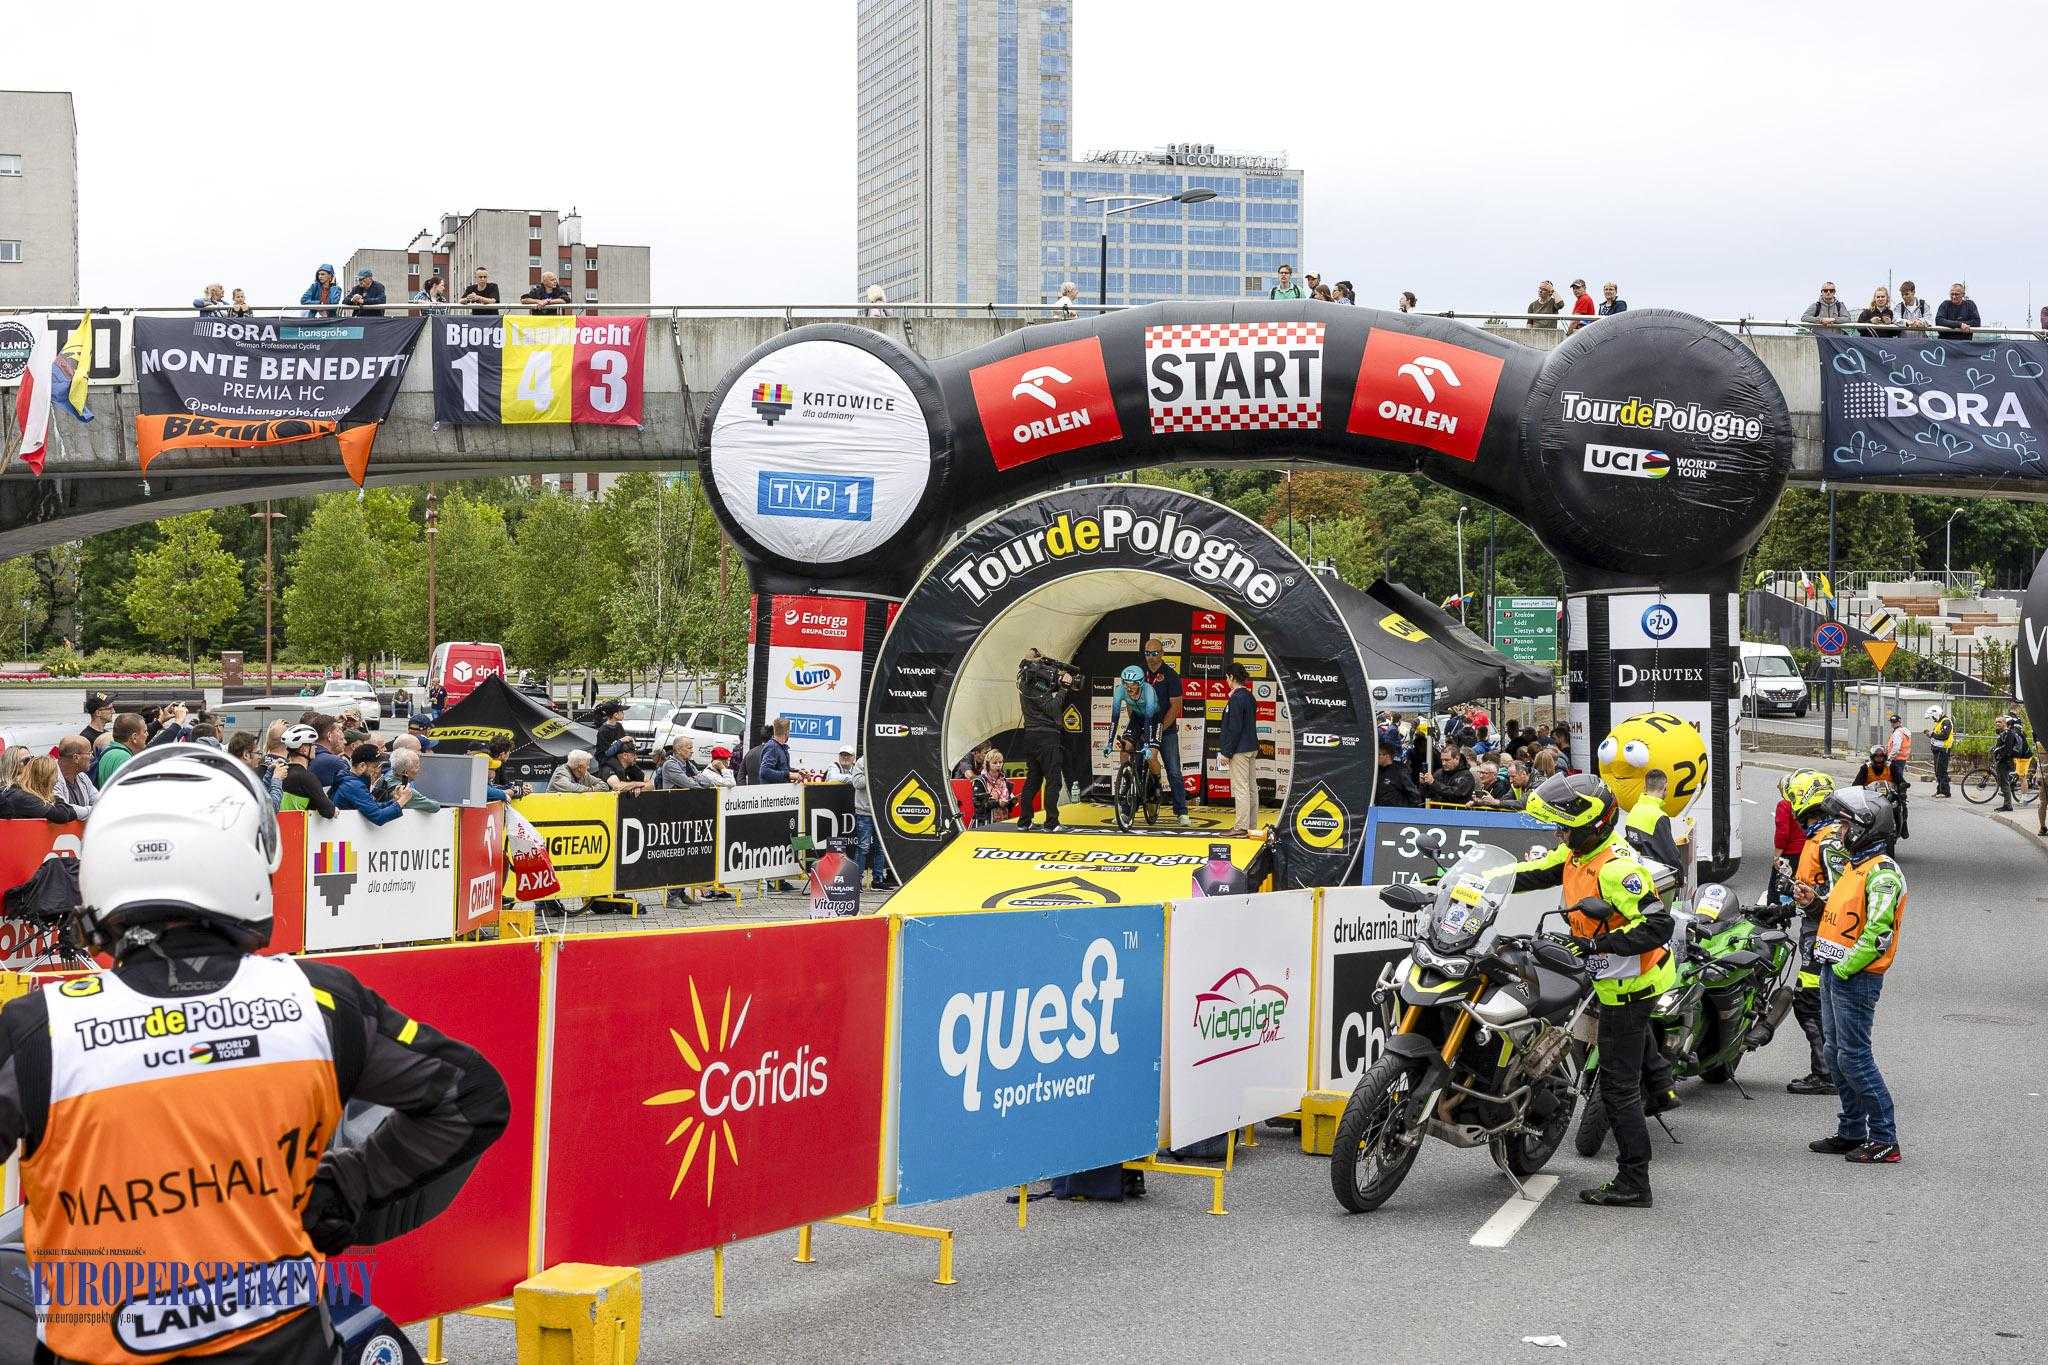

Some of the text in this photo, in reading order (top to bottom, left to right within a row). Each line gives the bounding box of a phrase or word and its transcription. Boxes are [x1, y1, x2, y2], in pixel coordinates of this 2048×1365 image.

[212, 323, 348, 341] BORA hansgrohe
[446, 324, 505, 348] Bjorg
[0, 341, 30, 350] LAND
[261, 342, 298, 350] Professional
[299, 342, 321, 351] Cycling
[141, 349, 249, 379] MONTE
[1150, 350, 1320, 402] START
[223, 382, 326, 401] PREMIA HC
[803, 392, 895, 412] KATOWICE
[1885, 386, 2032, 429] BORA
[803, 410, 855, 422] dla odmiany
[1378, 399, 1458, 435] ORLEN
[1013, 407, 1092, 444] ORLEN
[1591, 449, 1638, 472] UCI
[1677, 457, 1717, 470] WORLD
[1677, 467, 1707, 479] TOUR
[773, 482, 860, 514] TVP 1
[802, 612, 848, 628] Energa
[1650, 614, 1670, 630] PZU
[824, 629, 847, 637] ORLEN
[1514, 627, 1534, 635] Cieszyn
[476, 665, 499, 678] dpd
[795, 668, 831, 685] LOTTO
[897, 666, 936, 676] VITARADE
[1296, 672, 1339, 684] VITARADE
[1640, 668, 1703, 682] DRUTEX
[888, 689, 927, 699] VITARADE
[1305, 696, 1347, 708] VITARADE
[1394, 694, 1424, 703] Tent
[430, 729, 510, 740] LANGTEAM
[790, 718, 834, 737] TVP 1
[878, 726, 897, 735] UCI
[1306, 735, 1327, 745] UCI
[725, 795, 800, 811] drukarnia internetowa
[1303, 819, 1338, 828] LANGTEAM
[647, 818, 714, 847] DRUTEX
[368, 848, 450, 873] KATOWICE
[648, 845, 713, 860] ENGINEERED FOR YOU
[729, 841, 794, 873] Chroma
[1391, 870, 1421, 885] ITA
[368, 879, 416, 894] dla odmiany
[1218, 884, 1230, 892] FA
[471, 878, 495, 913] ORLEN
[814, 898, 856, 914] Vitargo
[1334, 913, 1398, 943] drukarnia
[1840, 911, 1861, 941] 2
[938, 937, 1125, 1113] quest
[1198, 999, 1286, 1041] viaggiare
[215, 1038, 251, 1051] WORLD
[1339, 1011, 1388, 1079] Ch
[143, 1049, 185, 1068] UCI
[218, 1048, 244, 1059] TOUR
[700, 1044, 828, 1117] Cofidis
[993, 1072, 1096, 1118] sportswear
